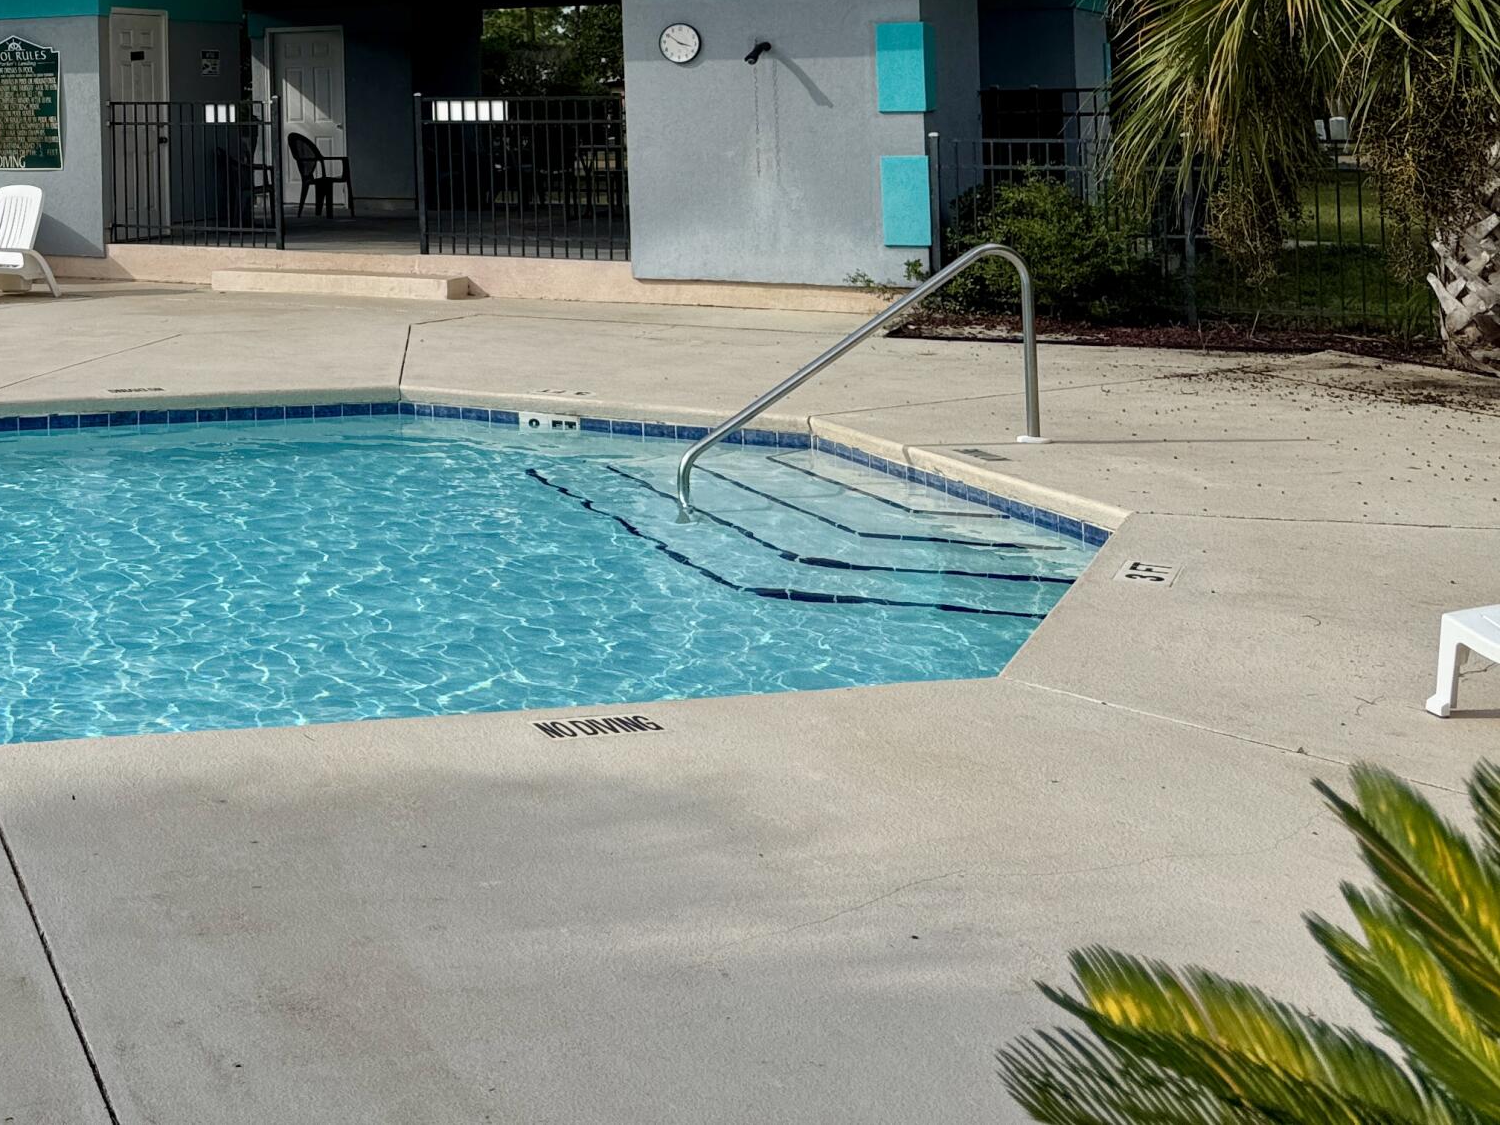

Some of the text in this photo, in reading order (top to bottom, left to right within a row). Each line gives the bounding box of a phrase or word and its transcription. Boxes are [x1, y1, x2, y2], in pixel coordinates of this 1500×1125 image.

[15, 50, 47, 60] RULES
[533, 716, 664, 738] NO DIVING
